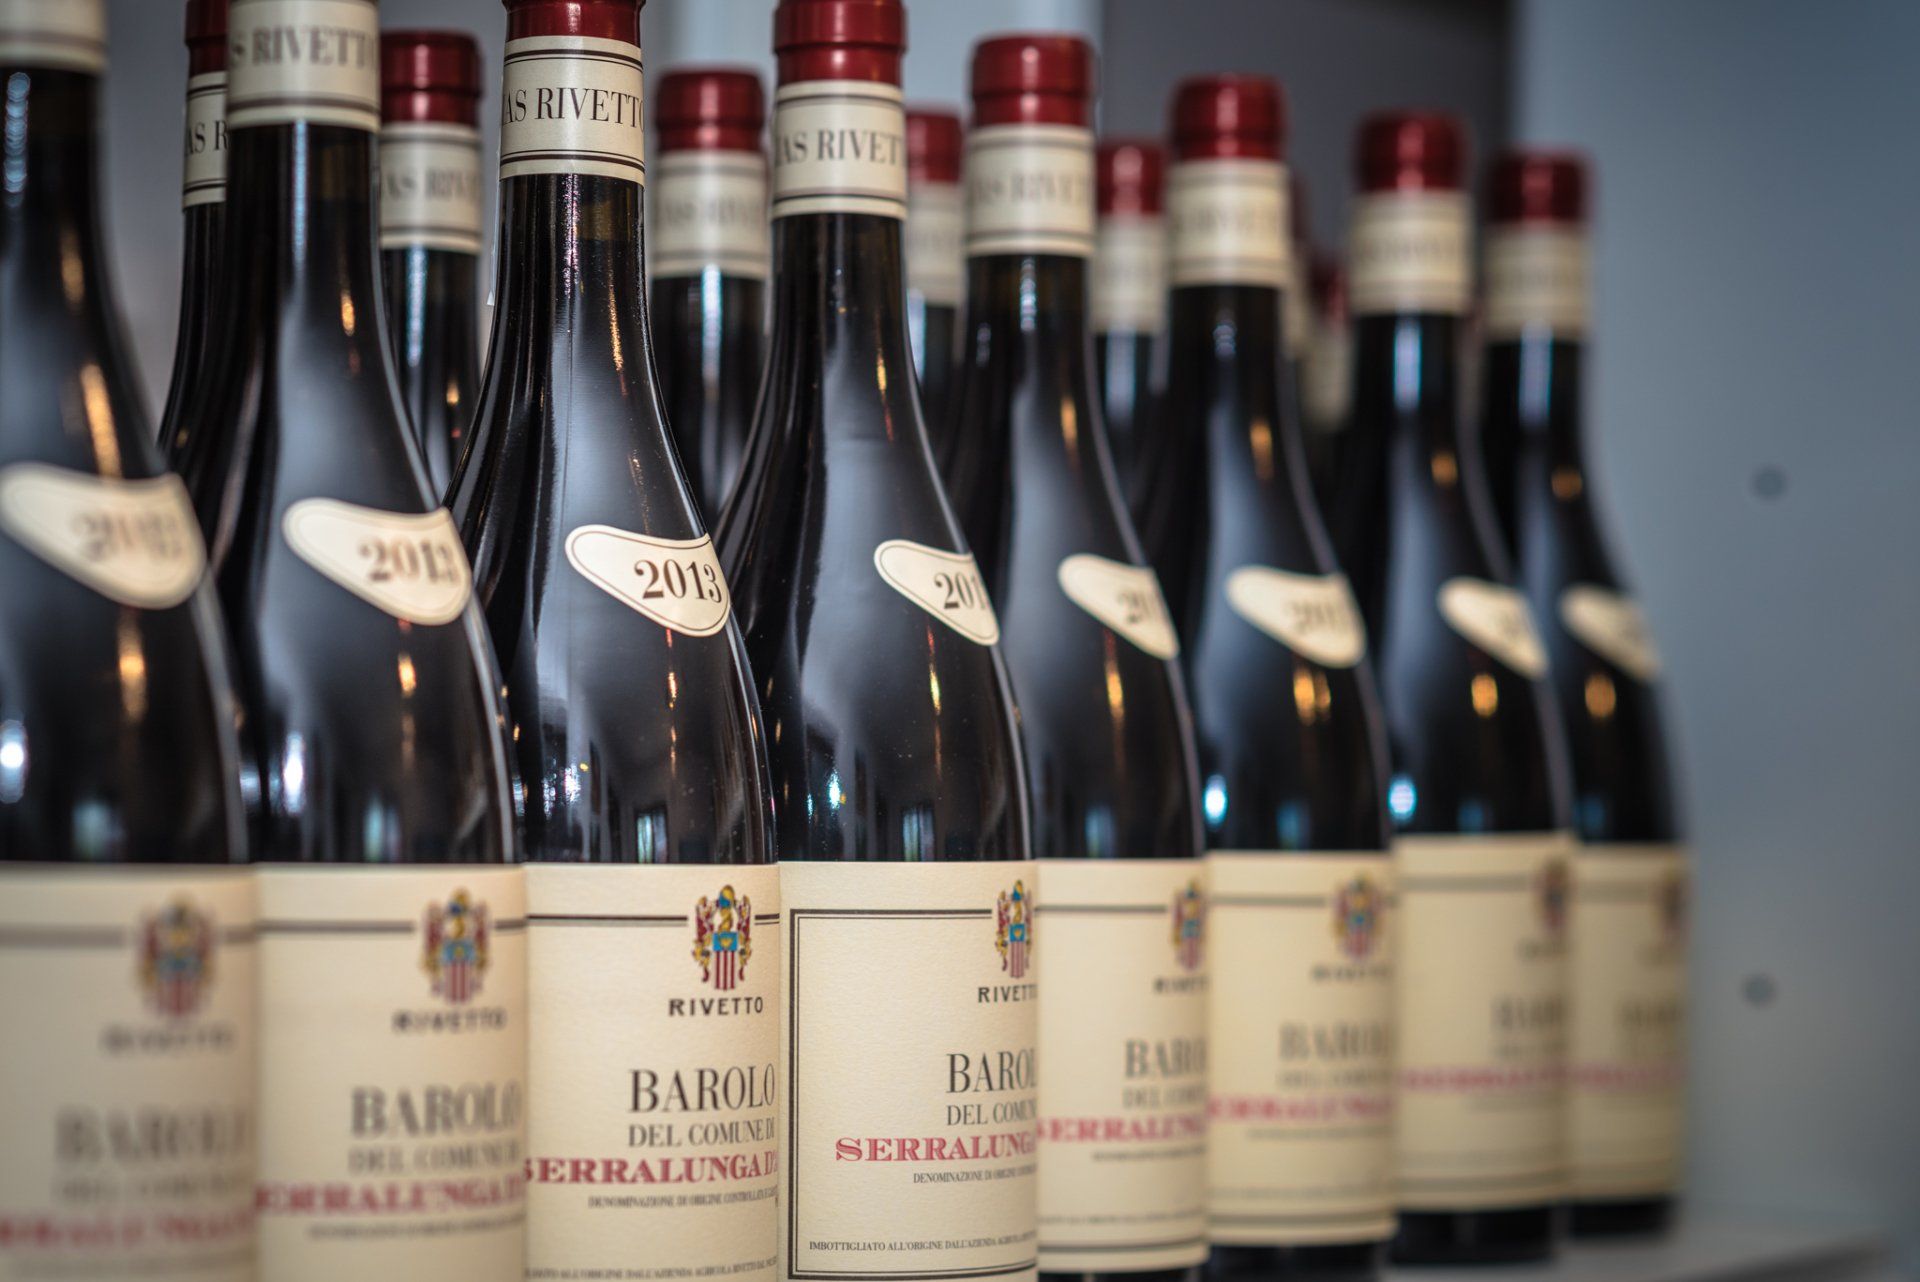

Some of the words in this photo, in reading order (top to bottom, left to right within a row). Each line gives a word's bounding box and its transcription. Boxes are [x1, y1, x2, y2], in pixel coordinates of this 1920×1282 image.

[634, 558, 723, 604] 2013
[669, 995, 764, 1017] RIVETTO
[628, 1062, 776, 1114] BAROLO
[946, 1103, 989, 1126] DEL
[628, 1122, 683, 1149] DEL
[687, 1117, 764, 1146] COMUNE
[912, 1169, 982, 1184] DENOMINAZIONE
[808, 1240, 886, 1251] IMBOTTIGLIATO
[887, 1239, 943, 1251] ALL'ORIGINE
